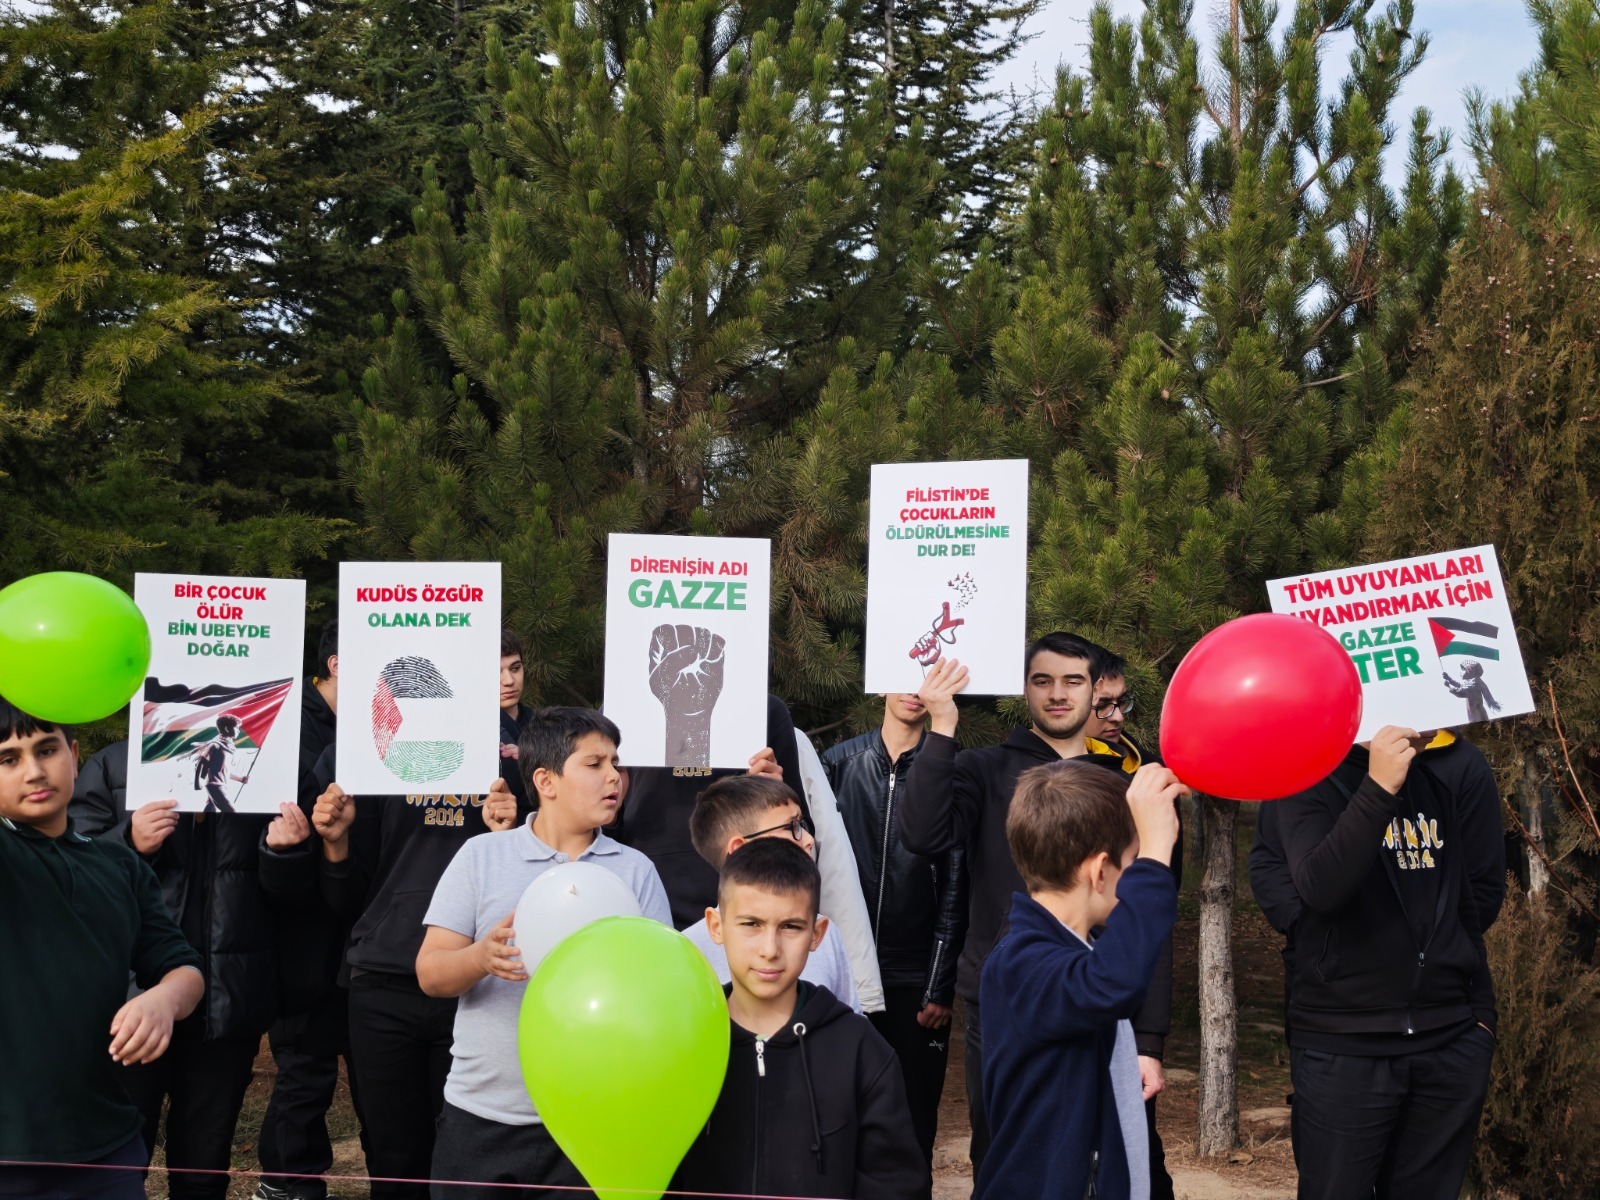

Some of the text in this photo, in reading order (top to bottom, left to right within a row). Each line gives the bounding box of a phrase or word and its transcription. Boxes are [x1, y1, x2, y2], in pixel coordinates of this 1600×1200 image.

[906, 487, 989, 502] FİLİSTİN'DE
[900, 507, 995, 523] ÇOCUKLARIN
[886, 523, 1010, 540] ÖLDÜRÜLMESİNE
[917, 544, 975, 556] DUR DE!
[630, 555, 748, 577] DİRENİŞİN ADI
[1283, 554, 1484, 604] TÜM UYUYANLARI
[174, 581, 267, 601] BİR ÇOCUK
[357, 584, 484, 602] KUDÜS ÖZGÜR
[628, 578, 747, 611] GAZZE
[197, 602, 243, 620] ÖLÜR
[1290, 579, 1493, 627] YANDIRMAK İÇİN
[168, 619, 271, 638] BİN UBEYDE
[368, 612, 471, 627] OLANA DEK
[1340, 621, 1416, 651] GAZZE
[187, 640, 250, 657] DOĞAR
[1351, 645, 1424, 684] TER
[424, 807, 465, 826] 2014
